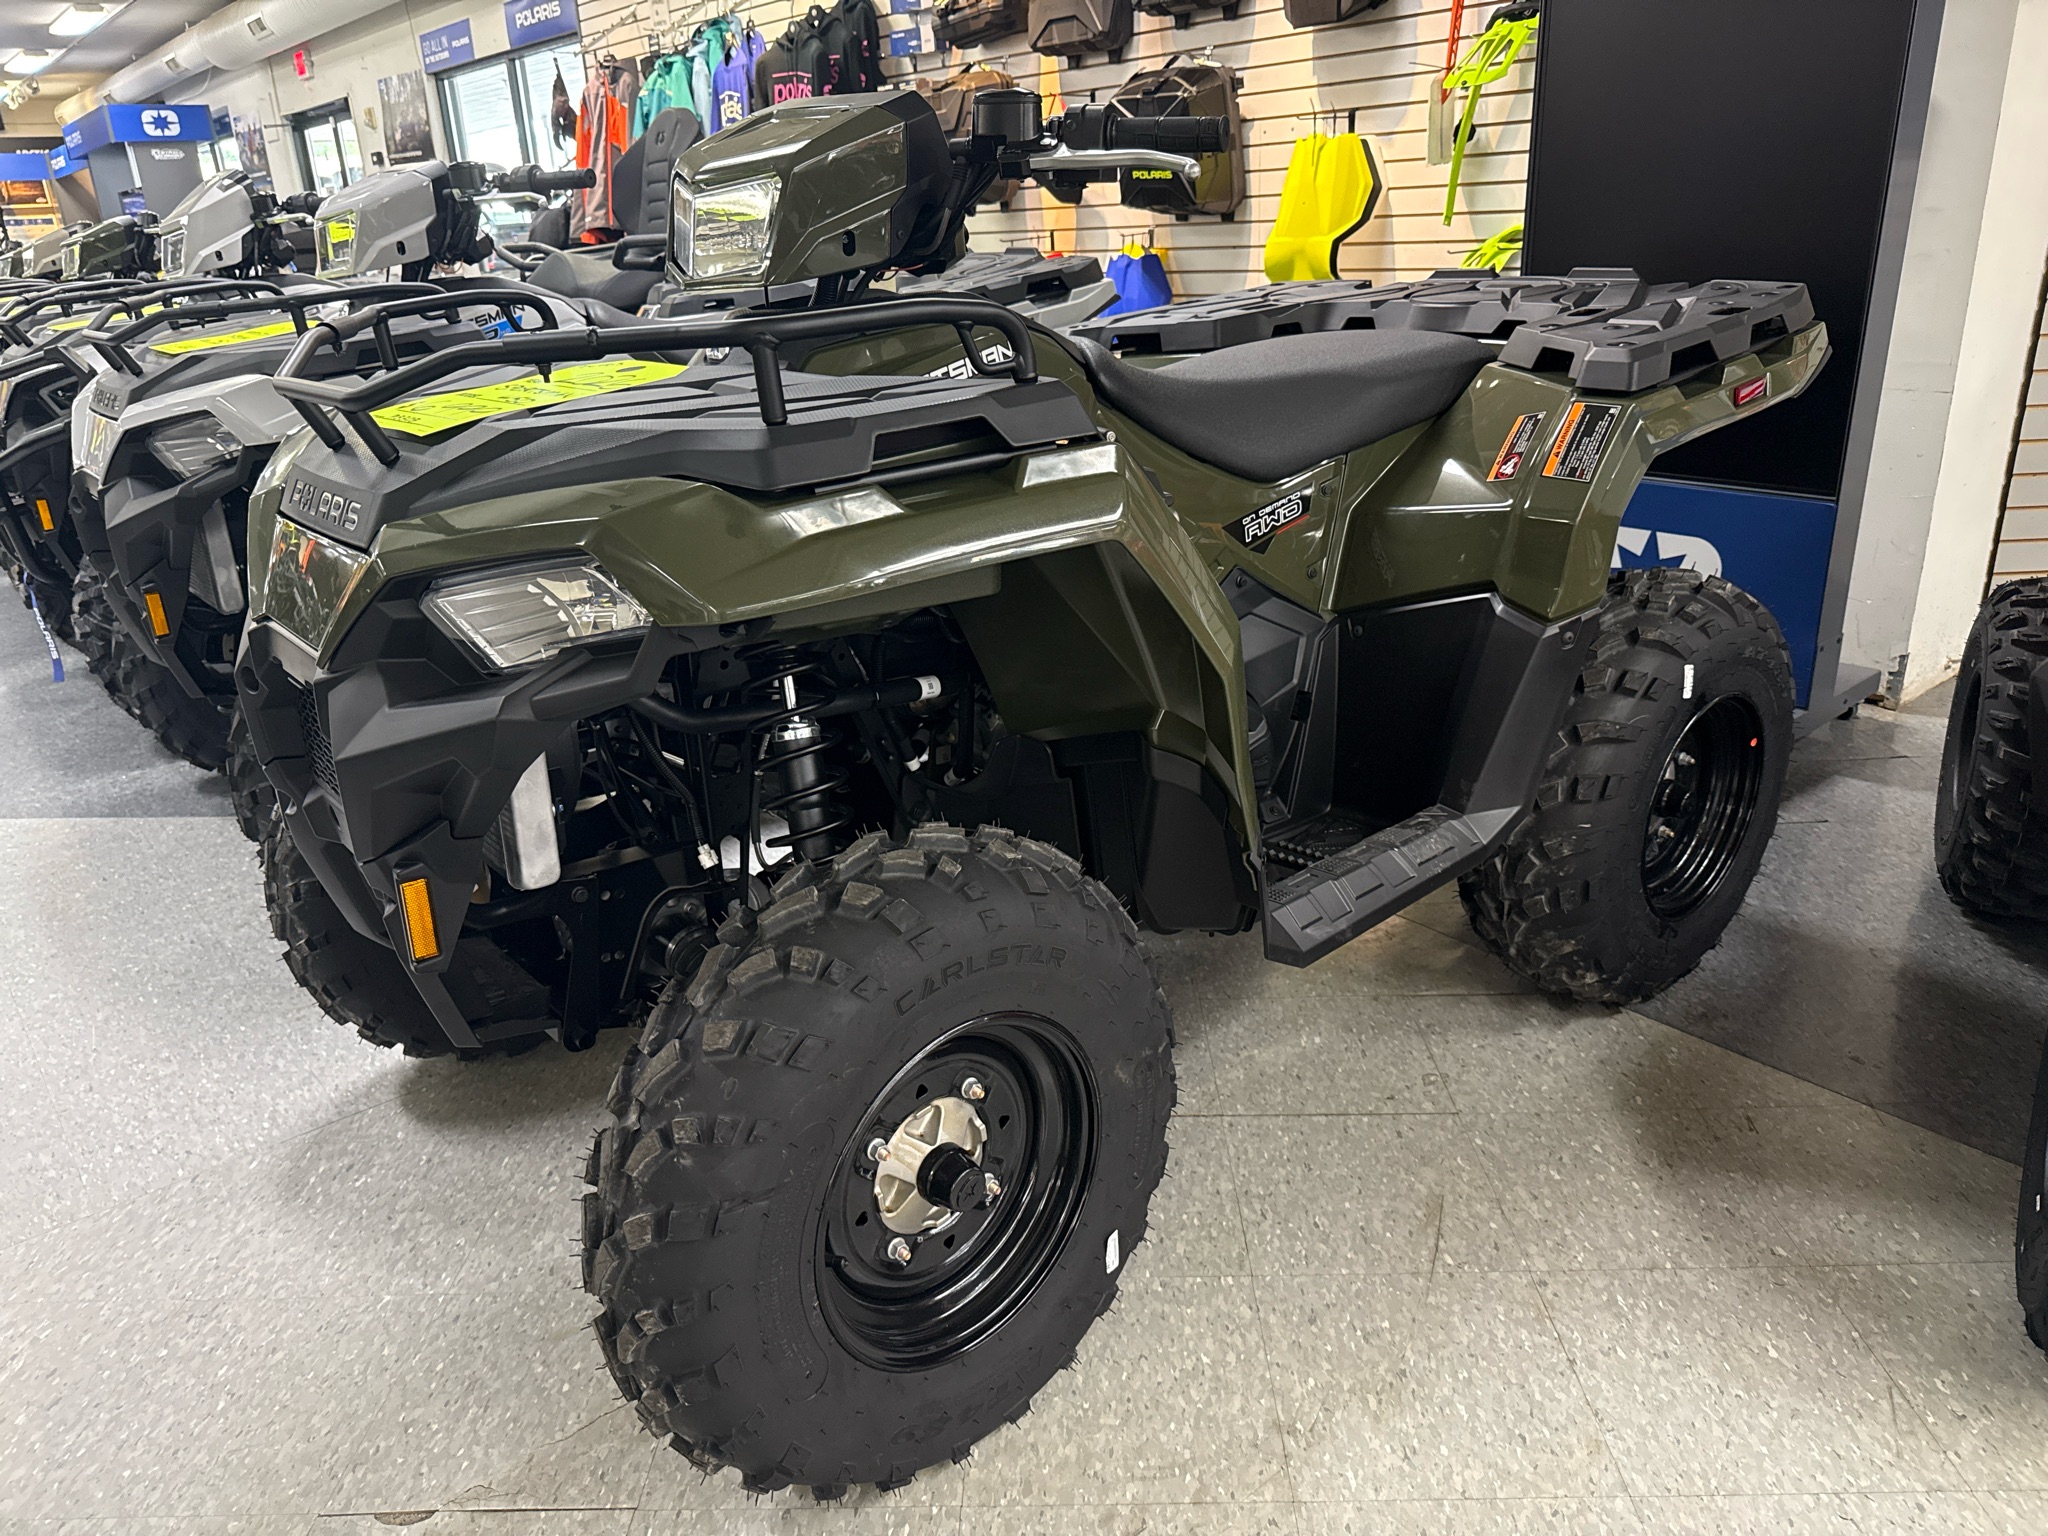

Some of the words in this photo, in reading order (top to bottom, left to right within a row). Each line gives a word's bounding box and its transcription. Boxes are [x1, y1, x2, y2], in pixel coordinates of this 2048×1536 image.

[515, 1, 561, 29] POLARIS
[431, 38, 442, 52] ALL
[1132, 169, 1173, 180] POLARIS
[1556, 419, 1575, 451] WARNING
[289, 478, 362, 532] POLARIS
[1258, 491, 1301, 517] DEMAND
[1244, 499, 1303, 543] AWD
[33, 606, 60, 660] POLARIS
[894, 943, 1067, 1016] CARLSTAR
